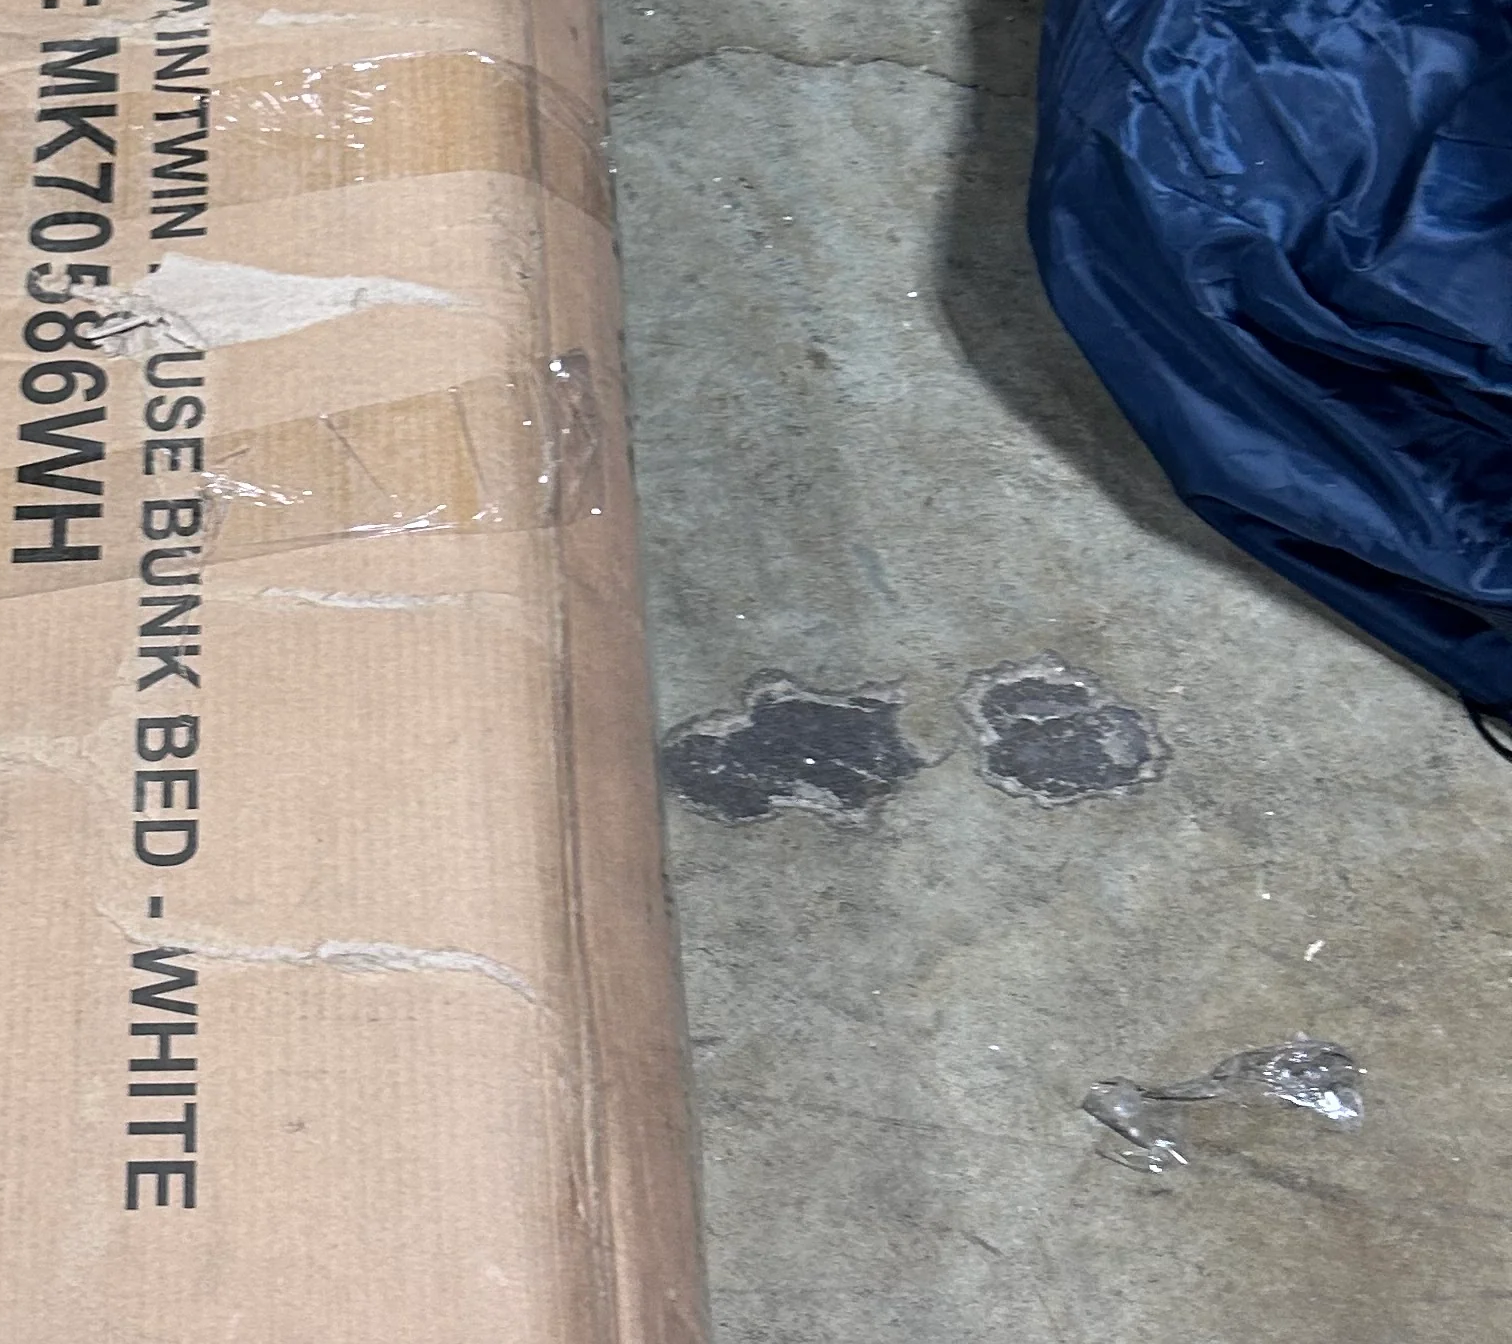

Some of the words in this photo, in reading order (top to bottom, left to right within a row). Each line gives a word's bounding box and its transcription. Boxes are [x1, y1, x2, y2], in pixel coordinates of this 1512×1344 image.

[12, 37, 120, 564] MK70586WH
[136, 499, 202, 691] BUNK
[134, 715, 200, 868] BED
[125, 948, 199, 1211] WHITE
